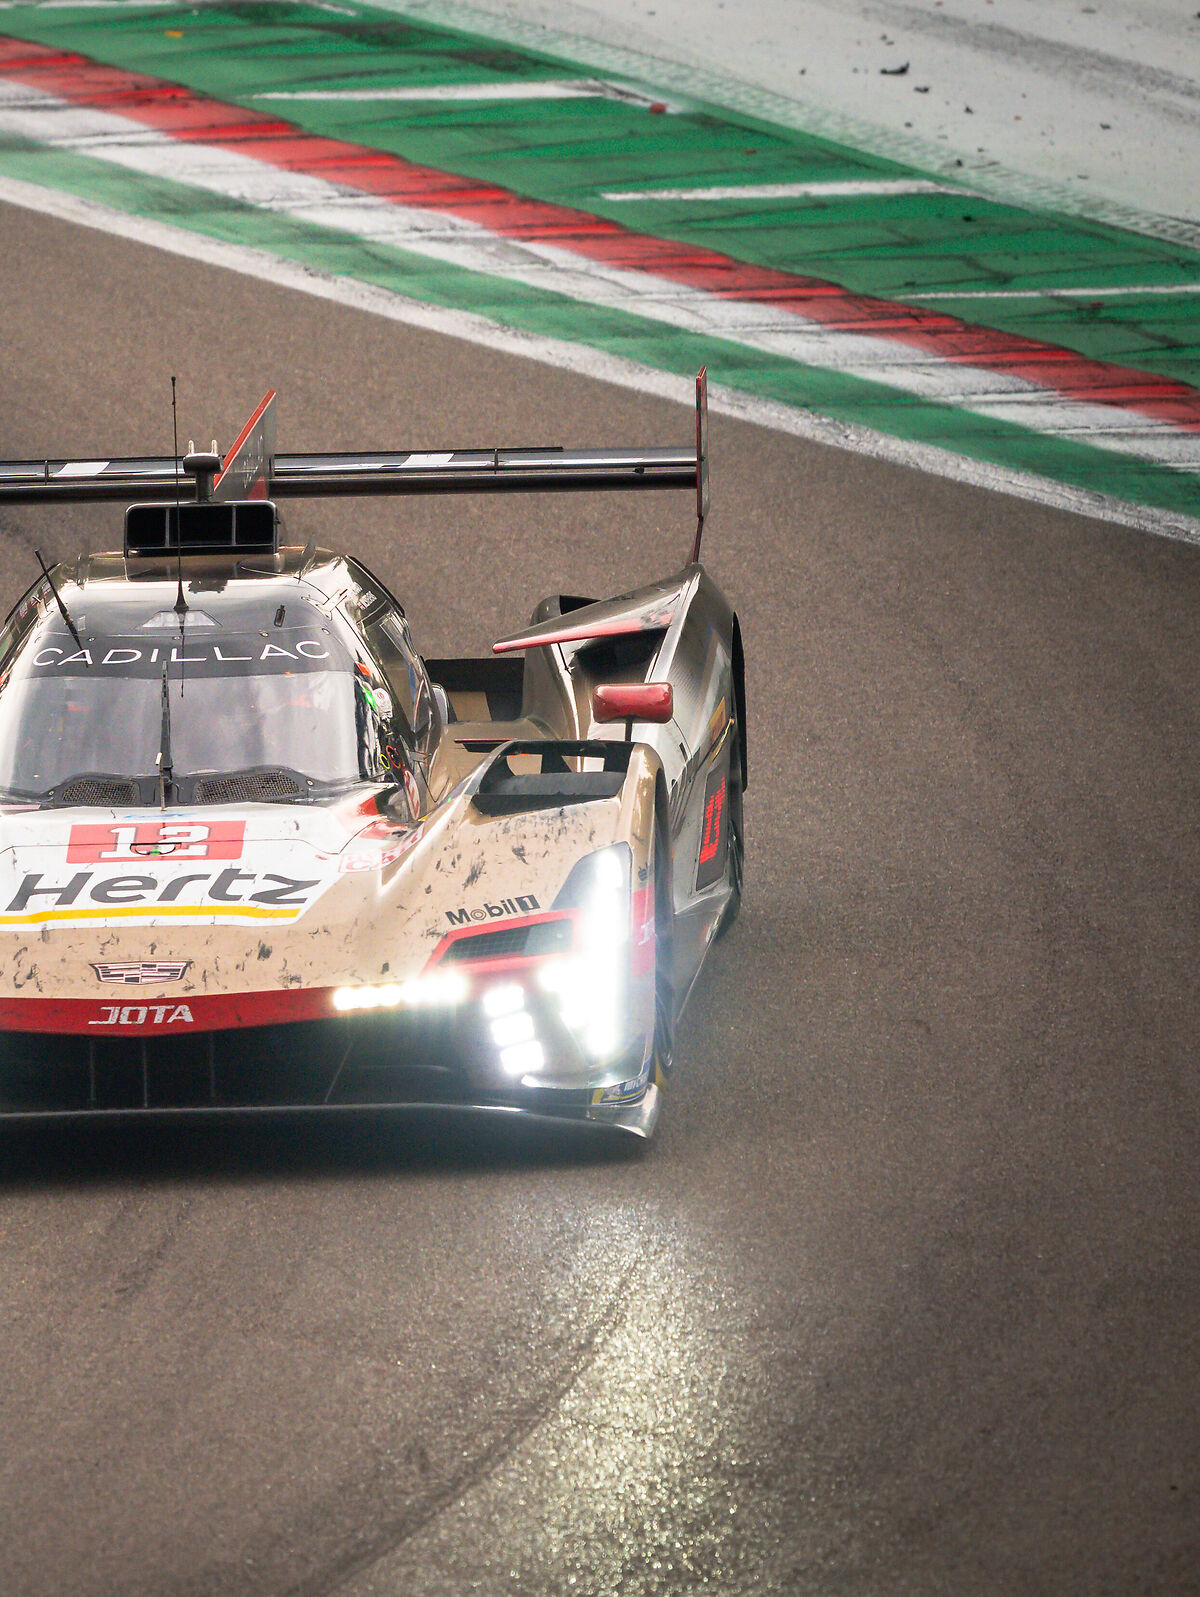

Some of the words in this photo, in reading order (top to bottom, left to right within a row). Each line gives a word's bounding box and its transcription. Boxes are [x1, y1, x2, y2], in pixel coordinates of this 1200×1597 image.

[32, 641, 330, 666] CADILLAC
[99, 824, 211, 860] 12
[5, 868, 322, 912] Hertz
[87, 1004, 194, 1025] JOTA
